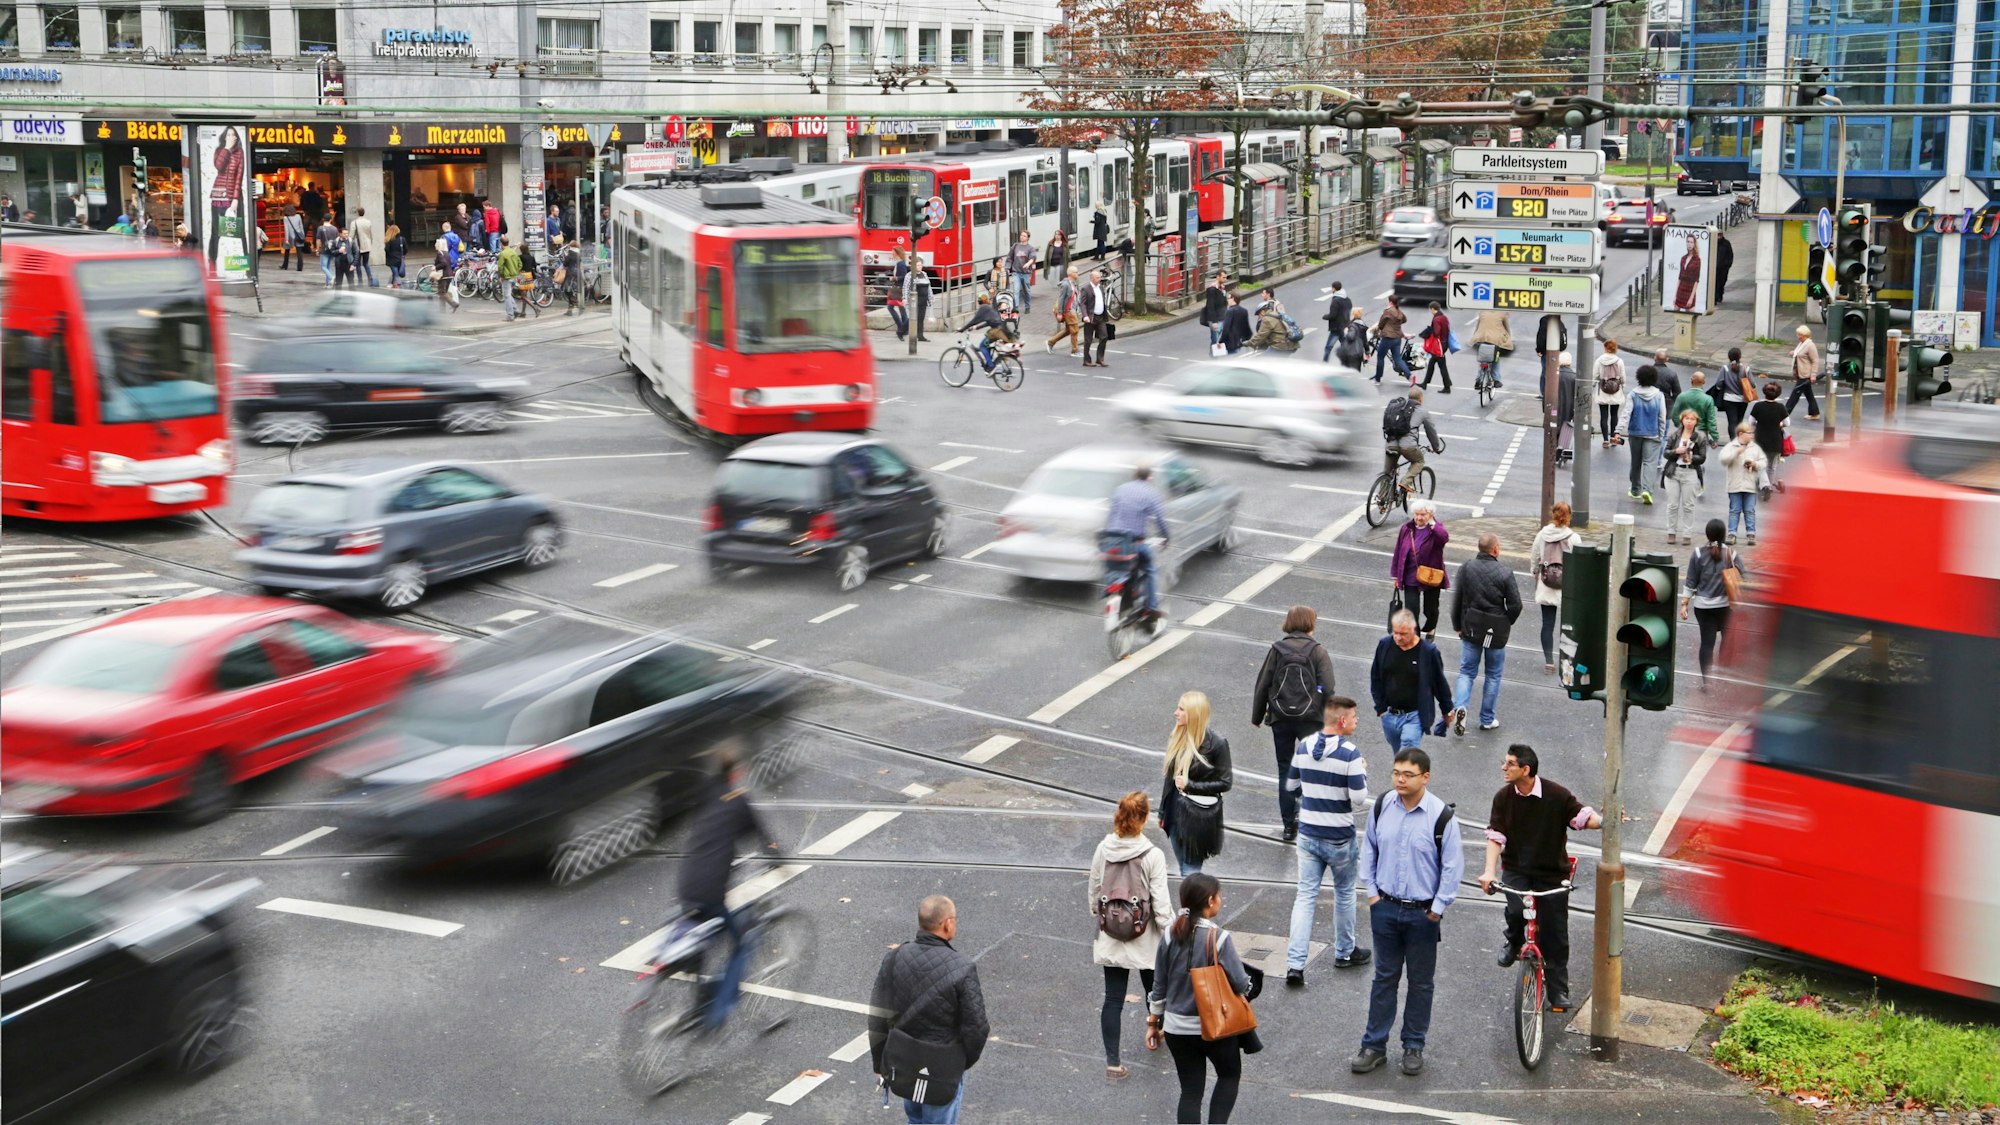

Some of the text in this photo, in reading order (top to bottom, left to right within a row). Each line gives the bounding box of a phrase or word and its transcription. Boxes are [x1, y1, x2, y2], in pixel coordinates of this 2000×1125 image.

[385, 25, 472, 44] paracelsus
[376, 42, 482, 59] heilpraktikerschule
[427, 124, 506, 144] Merzenich
[547, 136, 555, 147] 3
[644, 141, 691, 149] ONER-AKTION
[1046, 155, 1055, 166] 4
[1482, 154, 1567, 170] Parkleitsystem
[873, 172, 927, 183] 18 Buchheim
[1520, 186, 1568, 197] Dom/Rhein
[1512, 200, 1544, 217] 920
[1552, 208, 1588, 217] freie Plätze
[1521, 232, 1563, 243] Neumarkt
[1666, 228, 1709, 240] MANGO
[1500, 245, 1542, 262] 1578
[1550, 254, 1586, 263] freie Plätze
[1529, 277, 1553, 288] Ringe
[1498, 290, 1541, 308] 1480
[1549, 299, 1585, 309] freie Plätze
